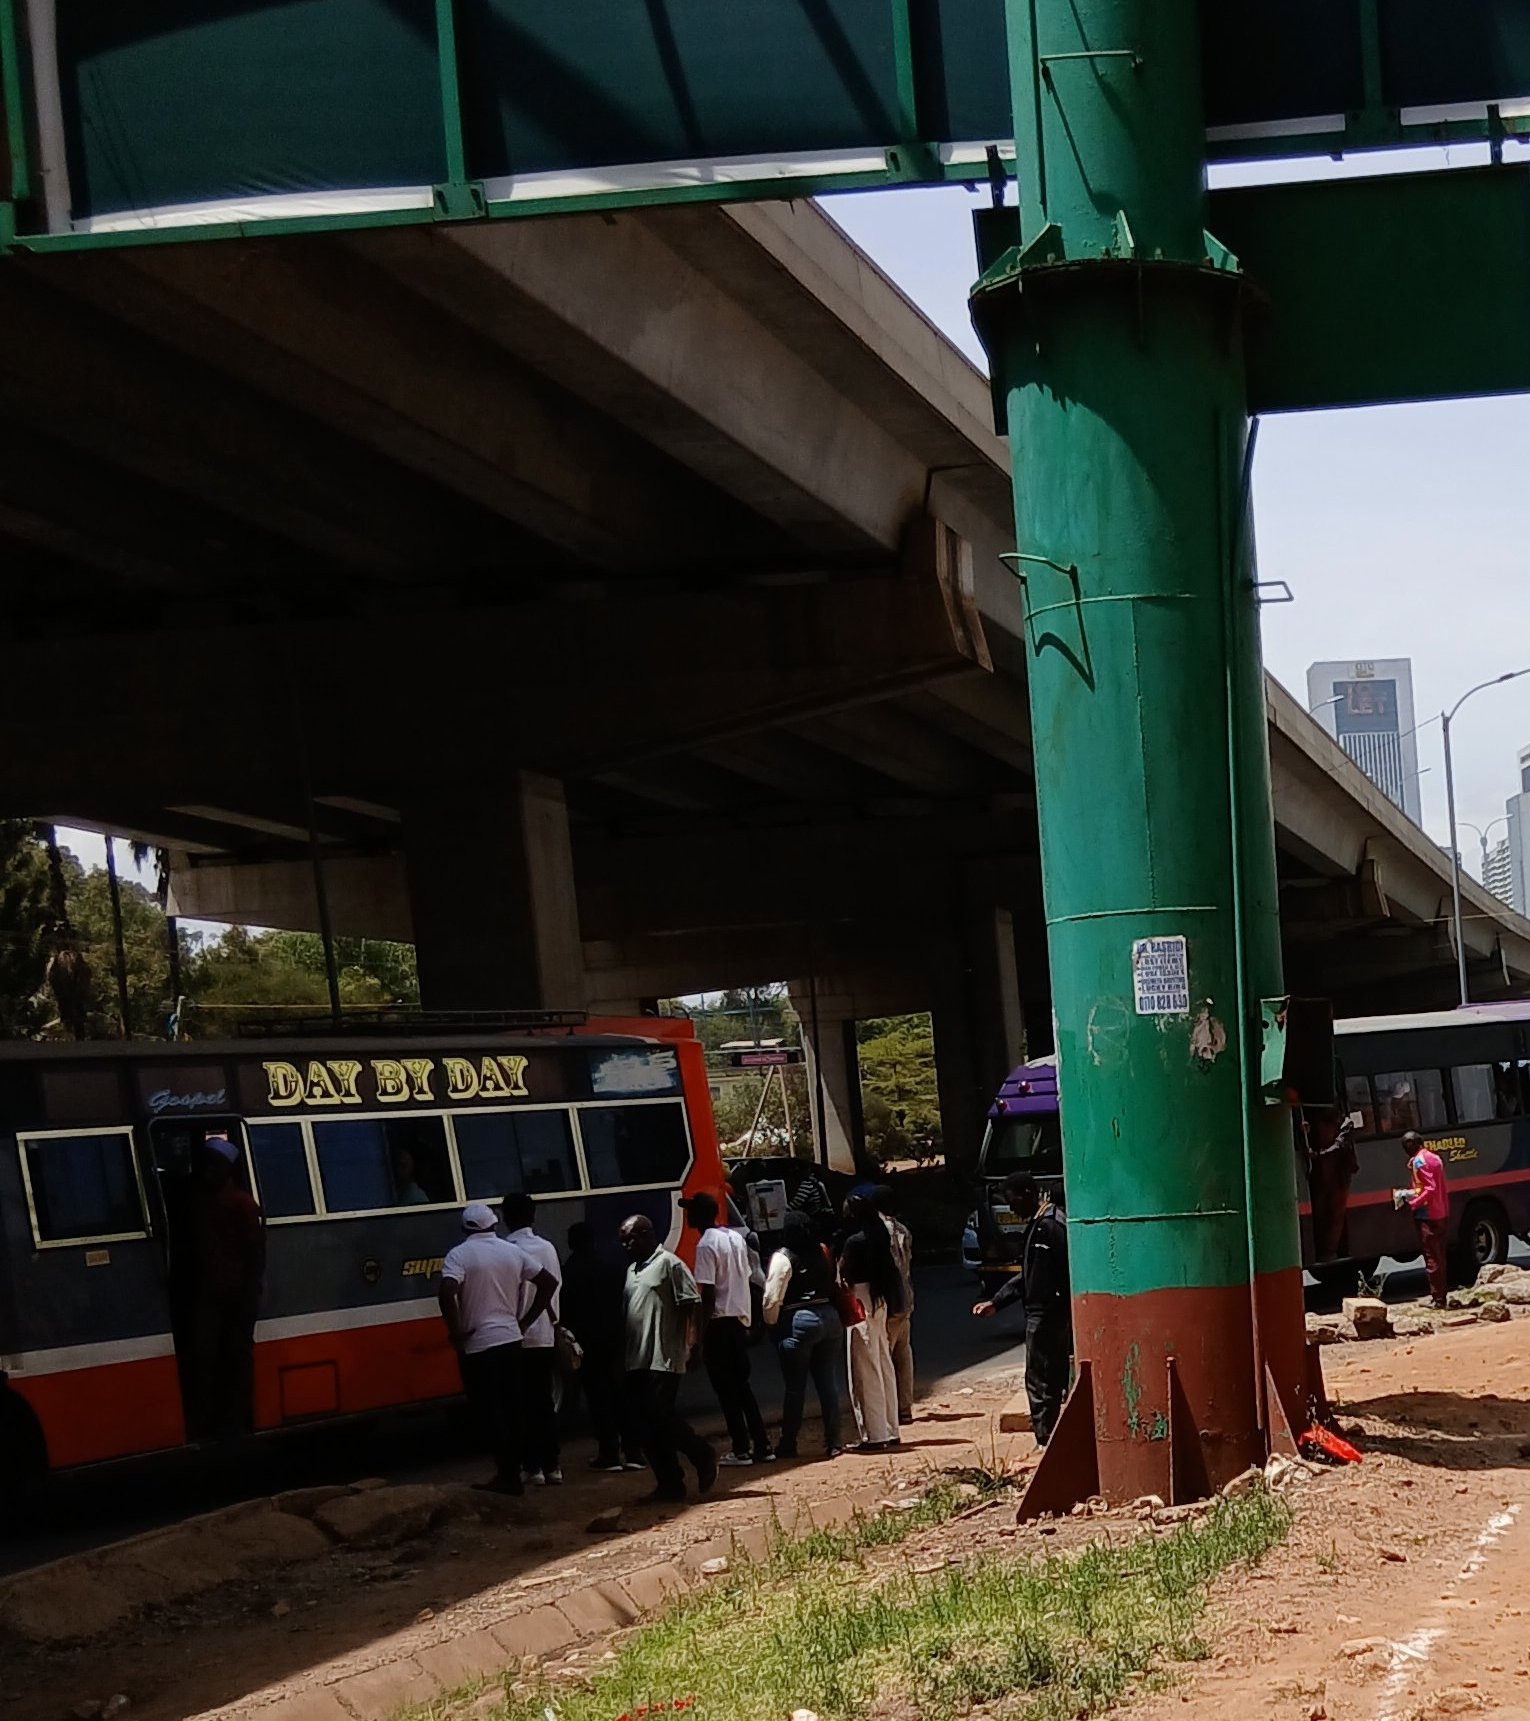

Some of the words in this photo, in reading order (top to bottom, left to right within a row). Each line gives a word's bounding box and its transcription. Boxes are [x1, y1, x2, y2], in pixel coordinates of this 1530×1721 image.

[262, 1060, 363, 1107] DAY
[372, 1057, 436, 1103] BY
[443, 1055, 530, 1098] DAY
[149, 1088, 227, 1114] Gospel
